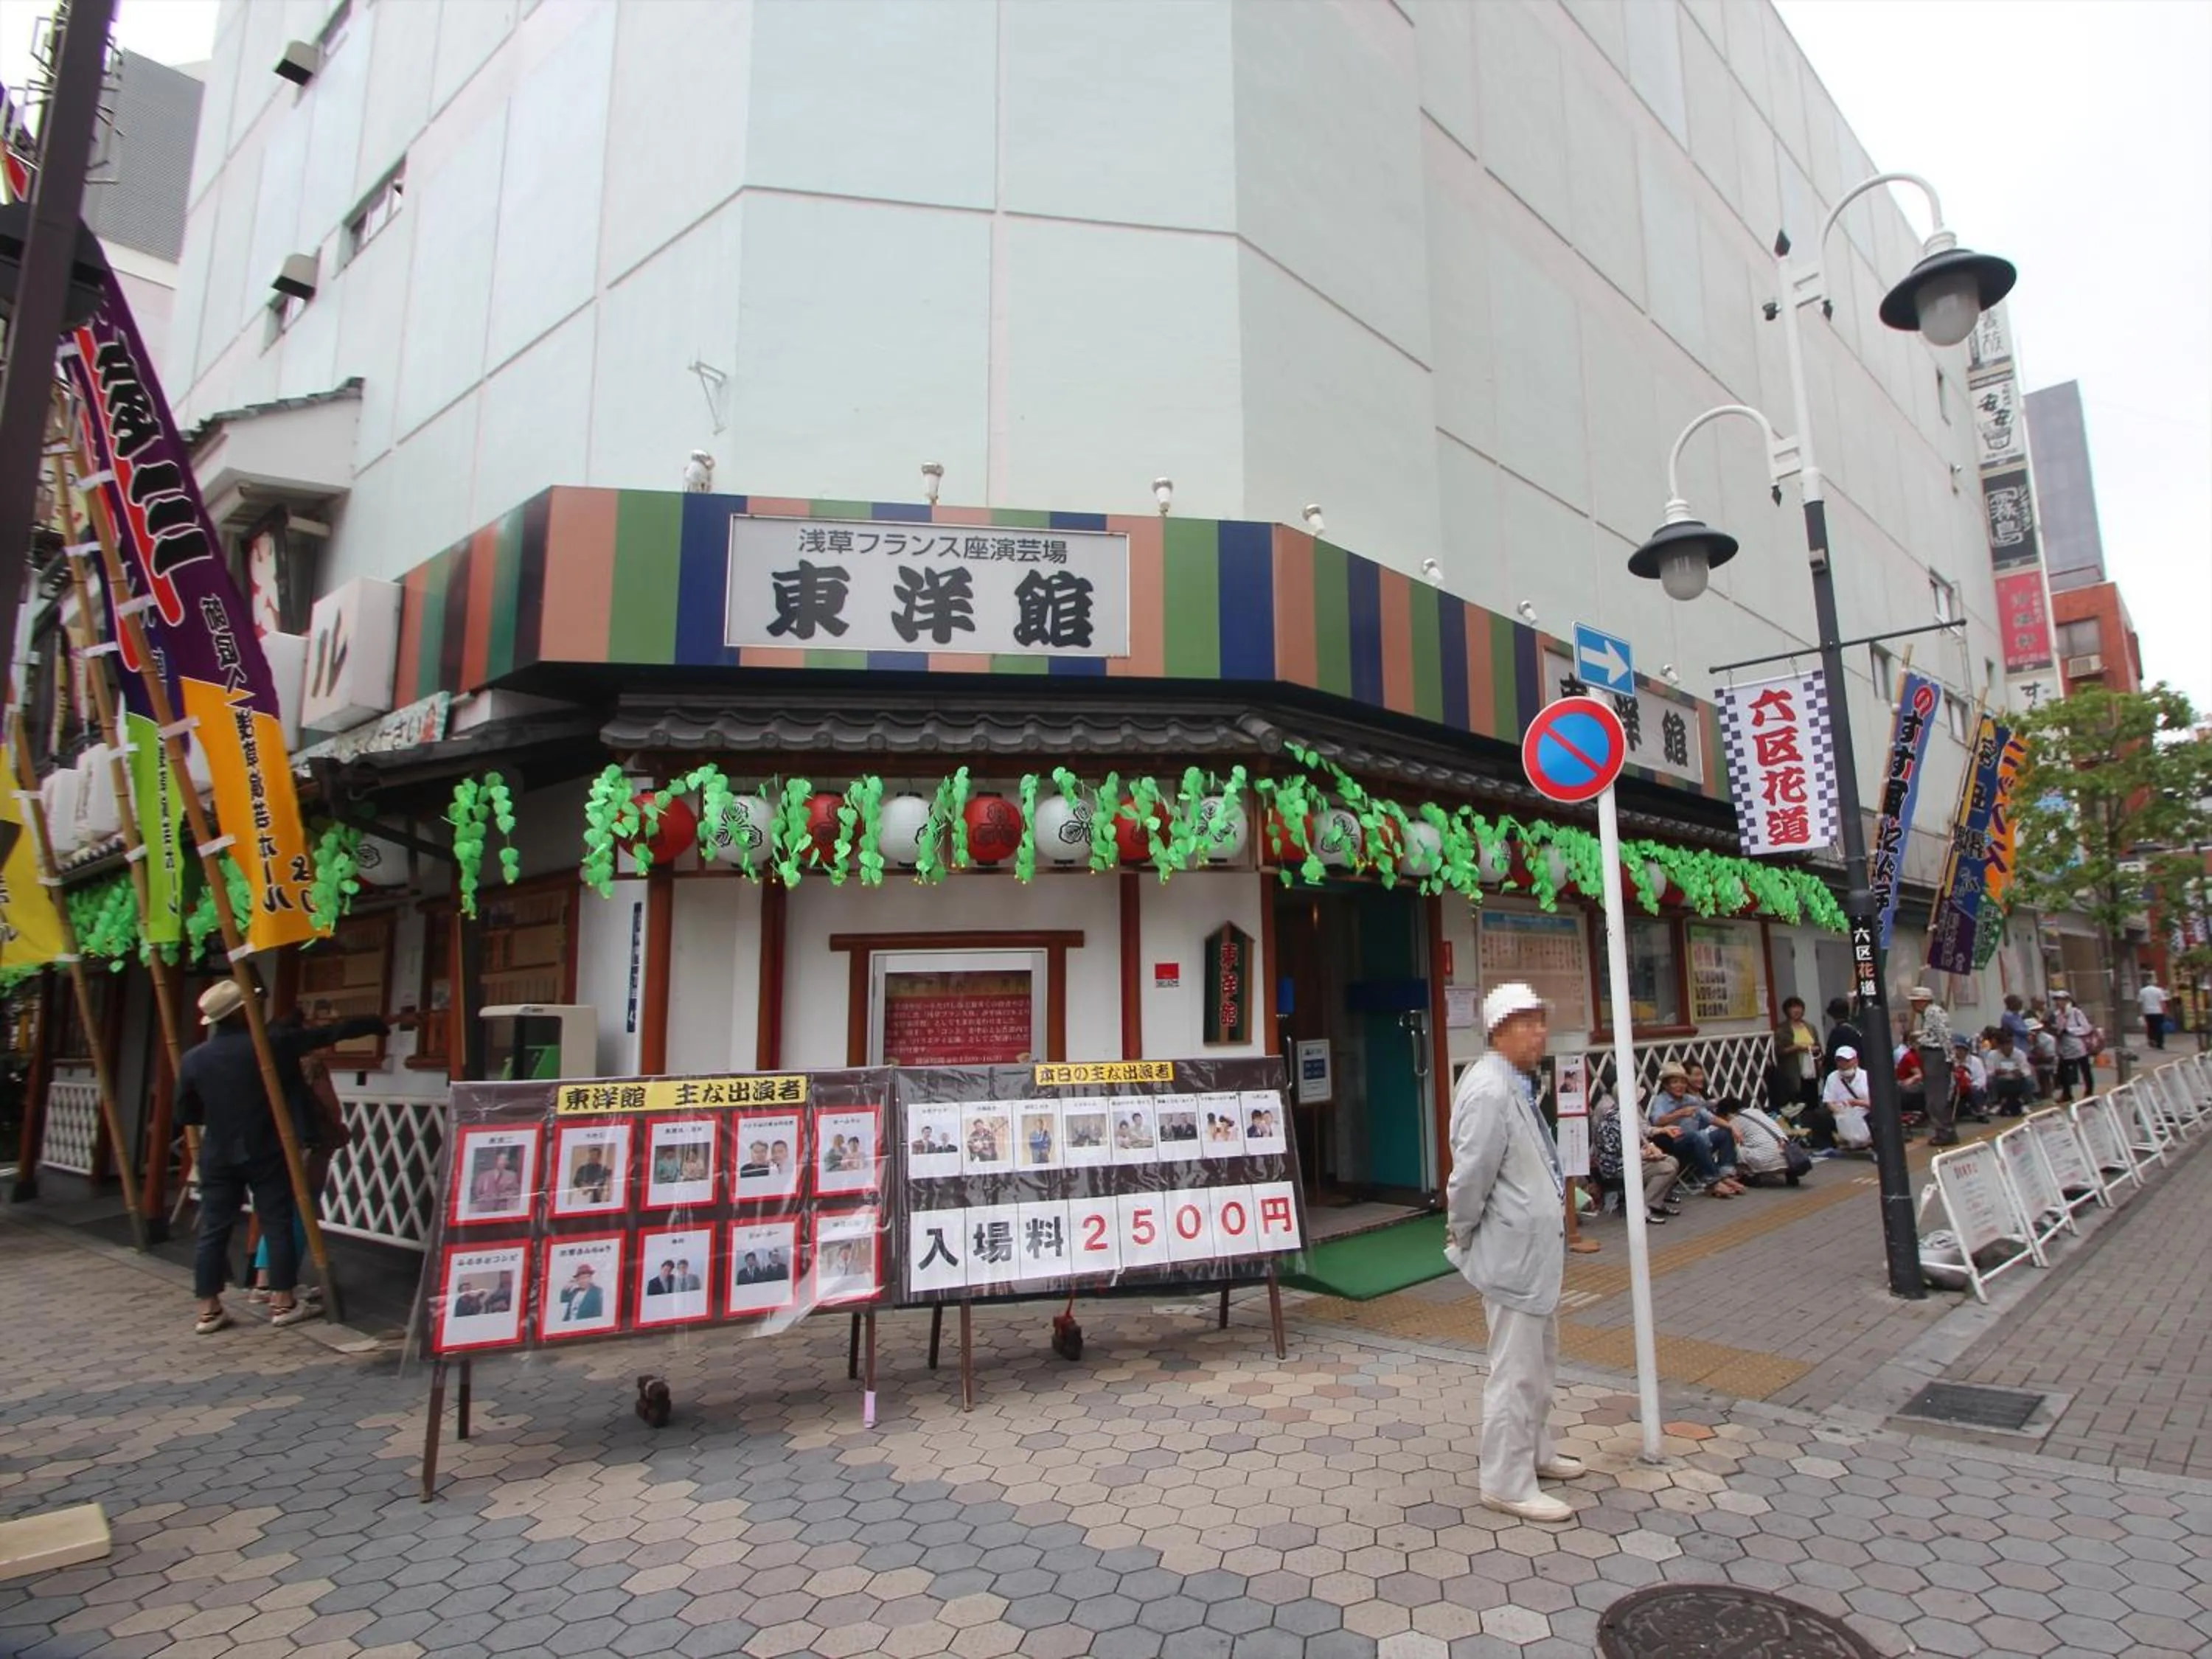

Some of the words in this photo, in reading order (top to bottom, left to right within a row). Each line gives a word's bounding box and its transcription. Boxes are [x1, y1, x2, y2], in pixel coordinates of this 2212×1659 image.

[799, 528, 1068, 564] 浅草フランス座演芸場
[767, 559, 1093, 648] 東洋館
[1747, 689, 1811, 847] 六区花道
[1220, 942, 1239, 1027] 東洋館
[1853, 928, 1877, 996] 六区花道
[564, 1085, 647, 1111] 東洋館
[675, 1079, 801, 1105] 主な出演者
[1040, 1063, 1169, 1083] 本日の主な出演者
[919, 1197, 1293, 1271] 入場料2500円
